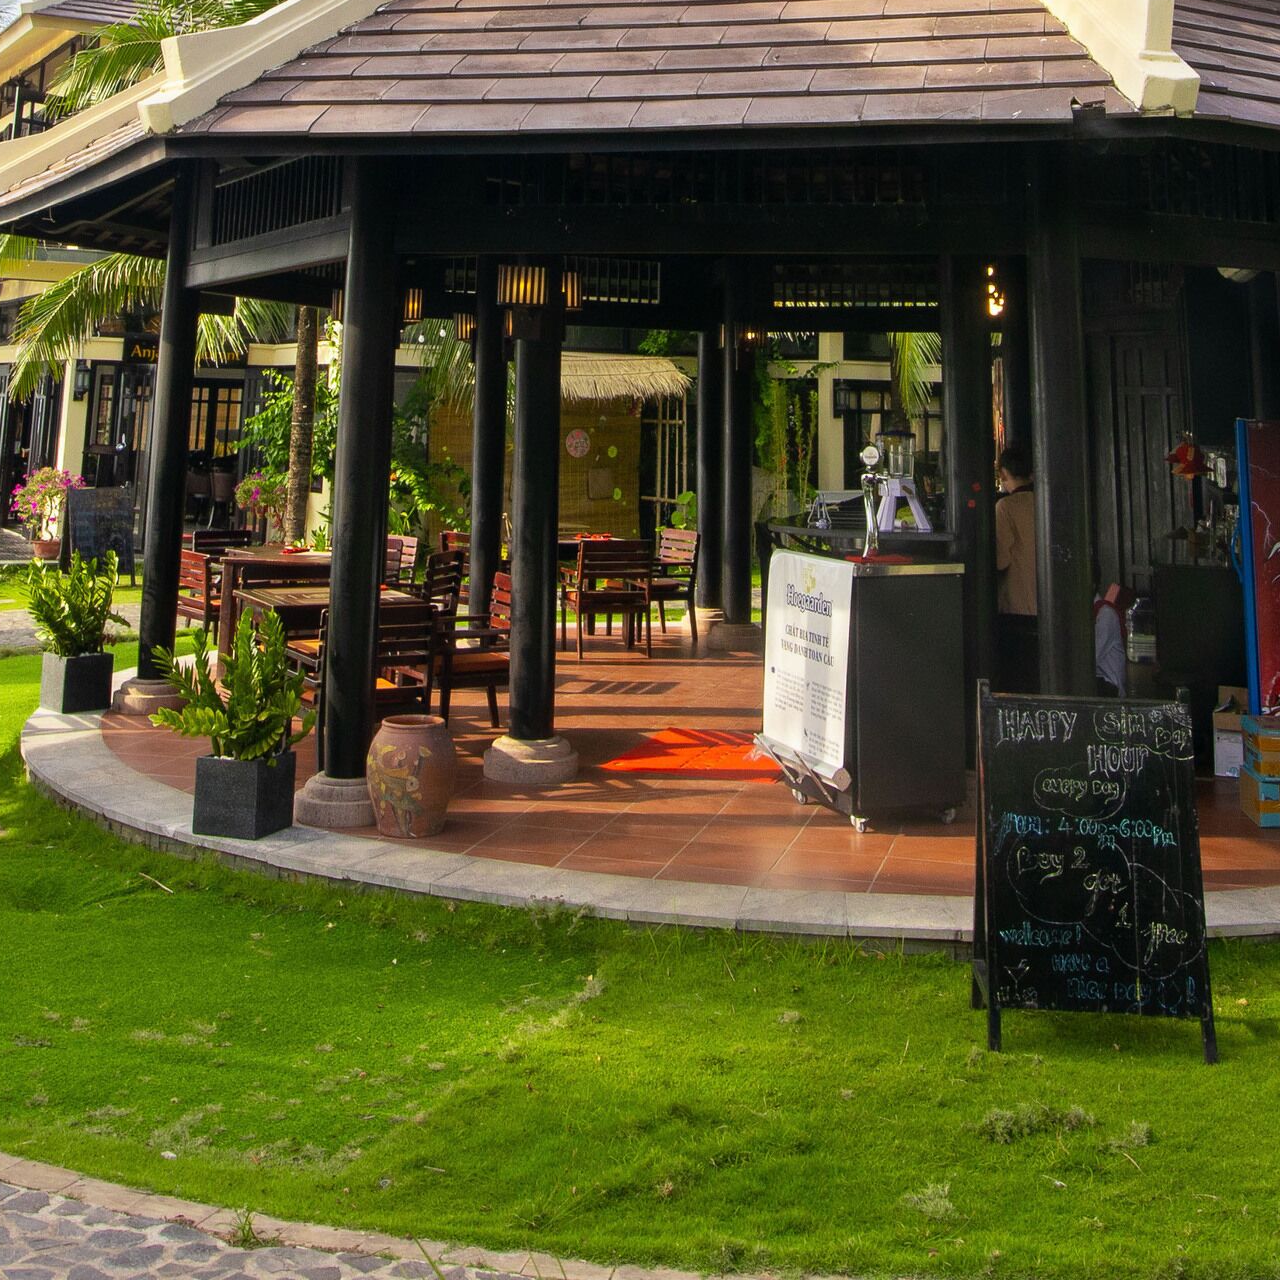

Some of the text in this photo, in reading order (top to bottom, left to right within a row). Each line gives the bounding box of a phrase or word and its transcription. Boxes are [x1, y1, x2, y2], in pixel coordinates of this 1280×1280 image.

[786, 584, 832, 618] Hoegaarden
[996, 708, 1078, 746] HAPPY
[1071, 846, 1090, 868] 2
